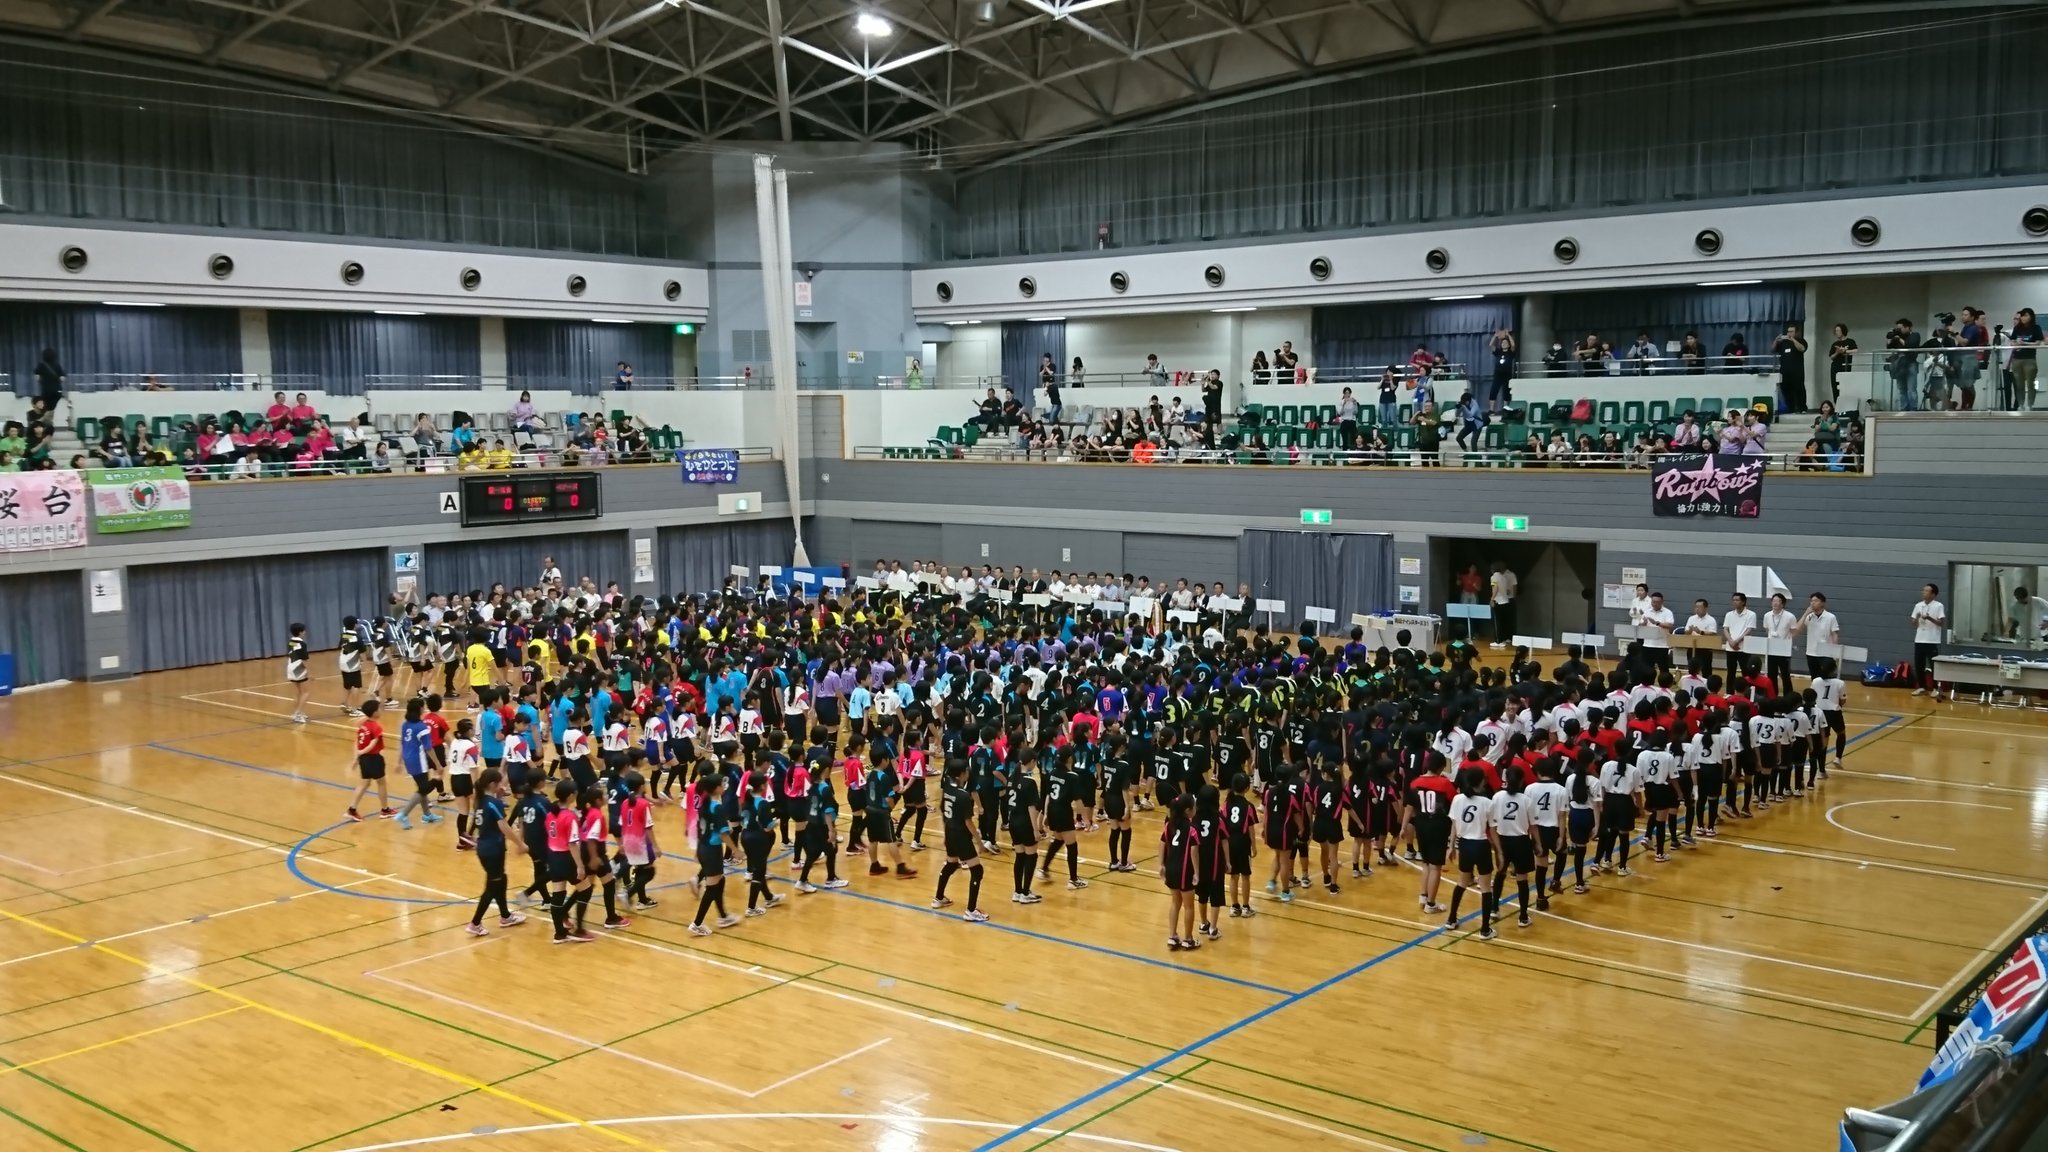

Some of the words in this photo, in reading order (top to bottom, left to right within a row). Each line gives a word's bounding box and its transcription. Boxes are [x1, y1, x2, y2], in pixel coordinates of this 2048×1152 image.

[1655, 468, 1759, 500] Rainbows
[443, 495, 457, 511] A
[471, 657, 477, 669] 6
[1198, 671, 1206, 683] 9
[1822, 685, 1831, 700] 1
[880, 702, 886, 713] 3
[976, 703, 985, 717] 2
[1041, 698, 1049, 711] 4
[1212, 697, 1224, 716] 5
[1239, 694, 1251, 713] 4
[1165, 704, 1176, 724] 3
[404, 728, 413, 742] 3
[714, 725, 720, 739] 5
[742, 721, 749, 733] 8
[1757, 723, 1774, 739] 13
[606, 735, 612, 747] 7
[1259, 734, 1268, 750] 8
[1290, 728, 1304, 744] 12
[1487, 732, 1497, 747] 8
[1632, 730, 1642, 749] 2
[566, 741, 573, 754] 6
[1445, 740, 1453, 754] 5
[452, 750, 458, 763] 3
[1220, 749, 1229, 765] 9
[1410, 753, 1416, 769] 1
[1154, 762, 1169, 780] 10
[1560, 756, 1570, 774] 7
[1649, 759, 1660, 776] 8
[1104, 772, 1113, 789] 7
[608, 789, 618, 804] 2
[1008, 789, 1017, 807] 2
[1050, 783, 1060, 800] 3
[1321, 792, 1332, 809] 4
[1417, 790, 1437, 813] 10
[1537, 791, 1551, 811] 4
[475, 809, 484, 826] 5
[943, 801, 953, 819] 5
[1230, 806, 1240, 823] 8
[1462, 805, 1478, 824] 6
[1503, 801, 1519, 821] 2
[1200, 820, 1211, 837] 3
